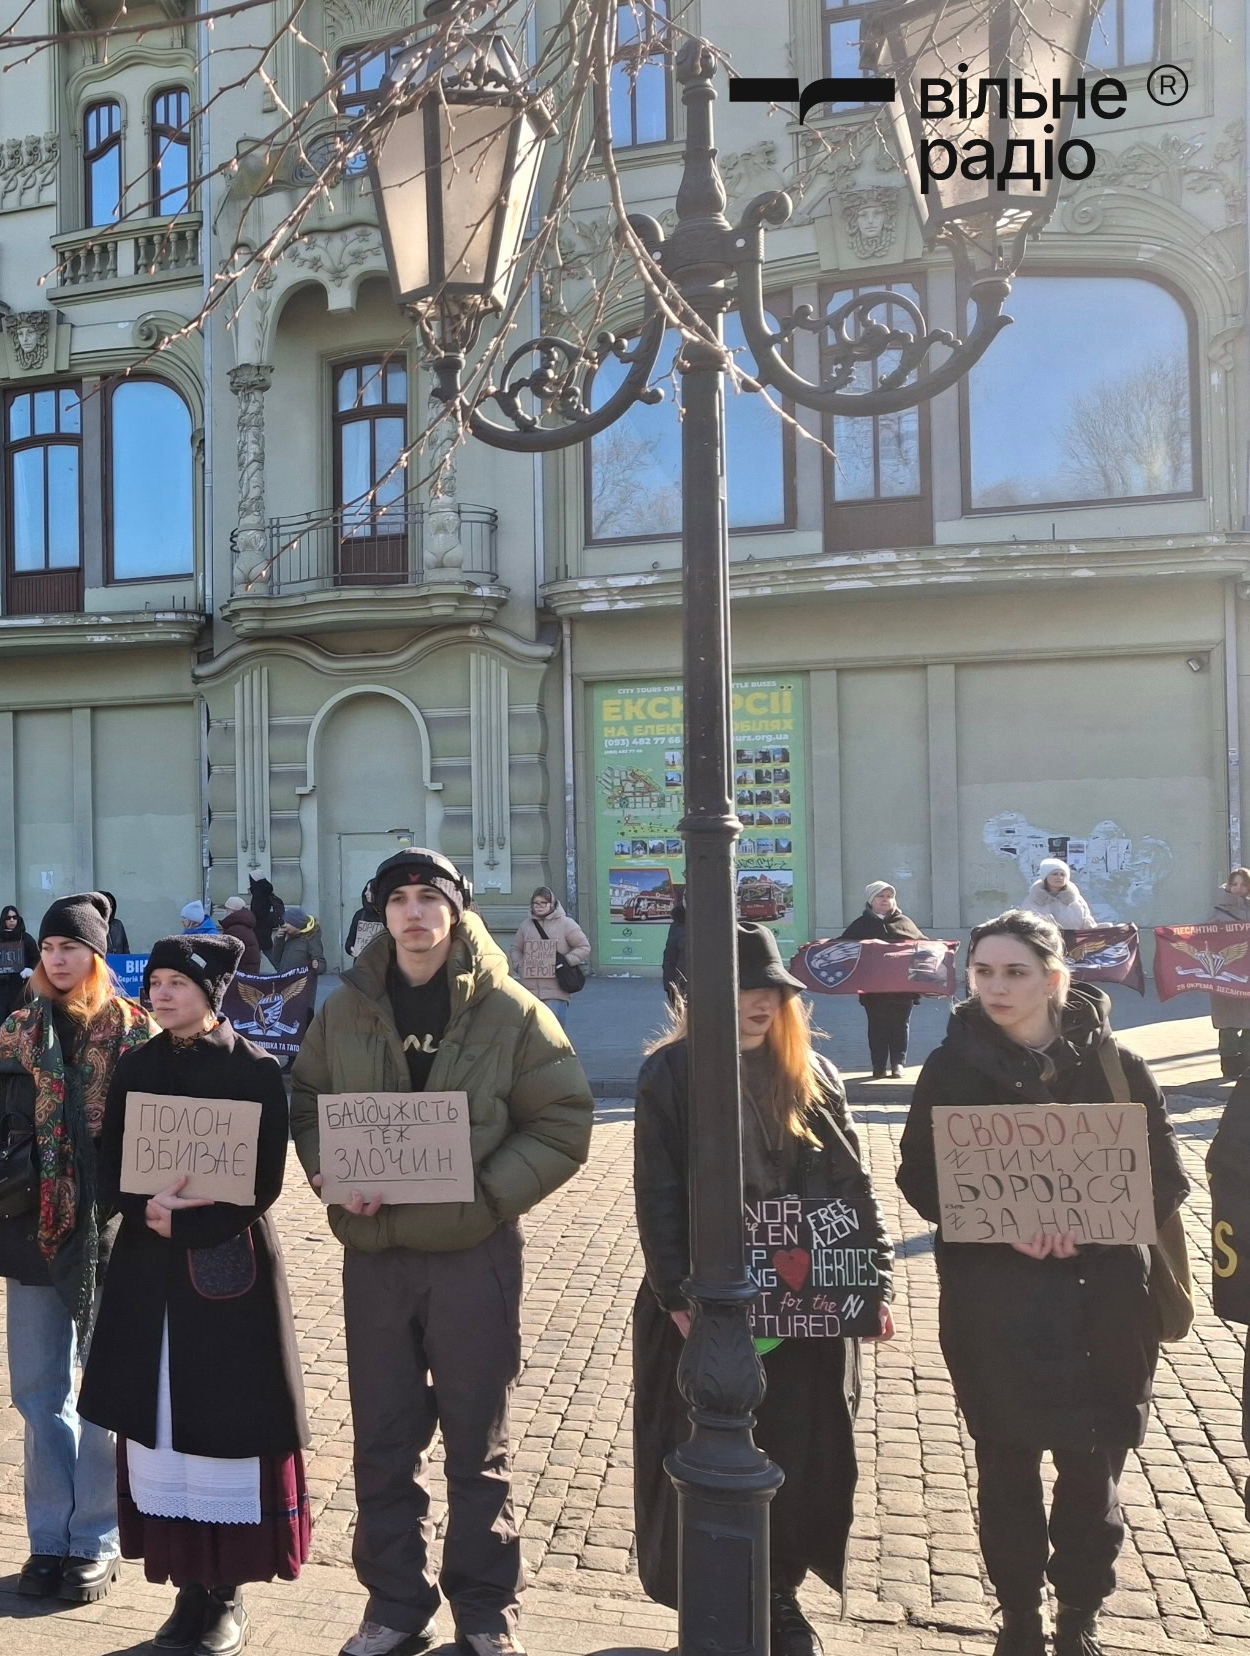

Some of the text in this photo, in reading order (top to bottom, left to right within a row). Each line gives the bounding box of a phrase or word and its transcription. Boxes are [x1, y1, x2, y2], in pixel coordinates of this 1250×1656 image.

[603, 685, 793, 721] ЕКСКРСІЇ
[604, 726, 628, 737] НА
[604, 736, 681, 748] (093) 482 77 66
[279, 1043, 286, 1051] ТА
[287, 1044, 300, 1052] ТАТО
[140, 1103, 232, 1137] ПОЛОН
[326, 1097, 458, 1128] БАЙДУЖІСТЬ
[363, 1127, 411, 1145] ТЕЖ
[948, 1111, 1124, 1147] СВОБОДУ
[136, 1136, 248, 1176] ВБИВАЄ
[334, 1148, 452, 1179] ЗЛОЧИН
[973, 1148, 1136, 1174] ТИМ, ХТО
[954, 1173, 1131, 1204] БОРОВСЯ
[806, 1199, 852, 1230] FREE
[812, 1209, 859, 1250] AZOV
[975, 1208, 1140, 1241] ЗА НАШУ
[811, 1248, 879, 1287] HEROES
[780, 1292, 837, 1313] for the
